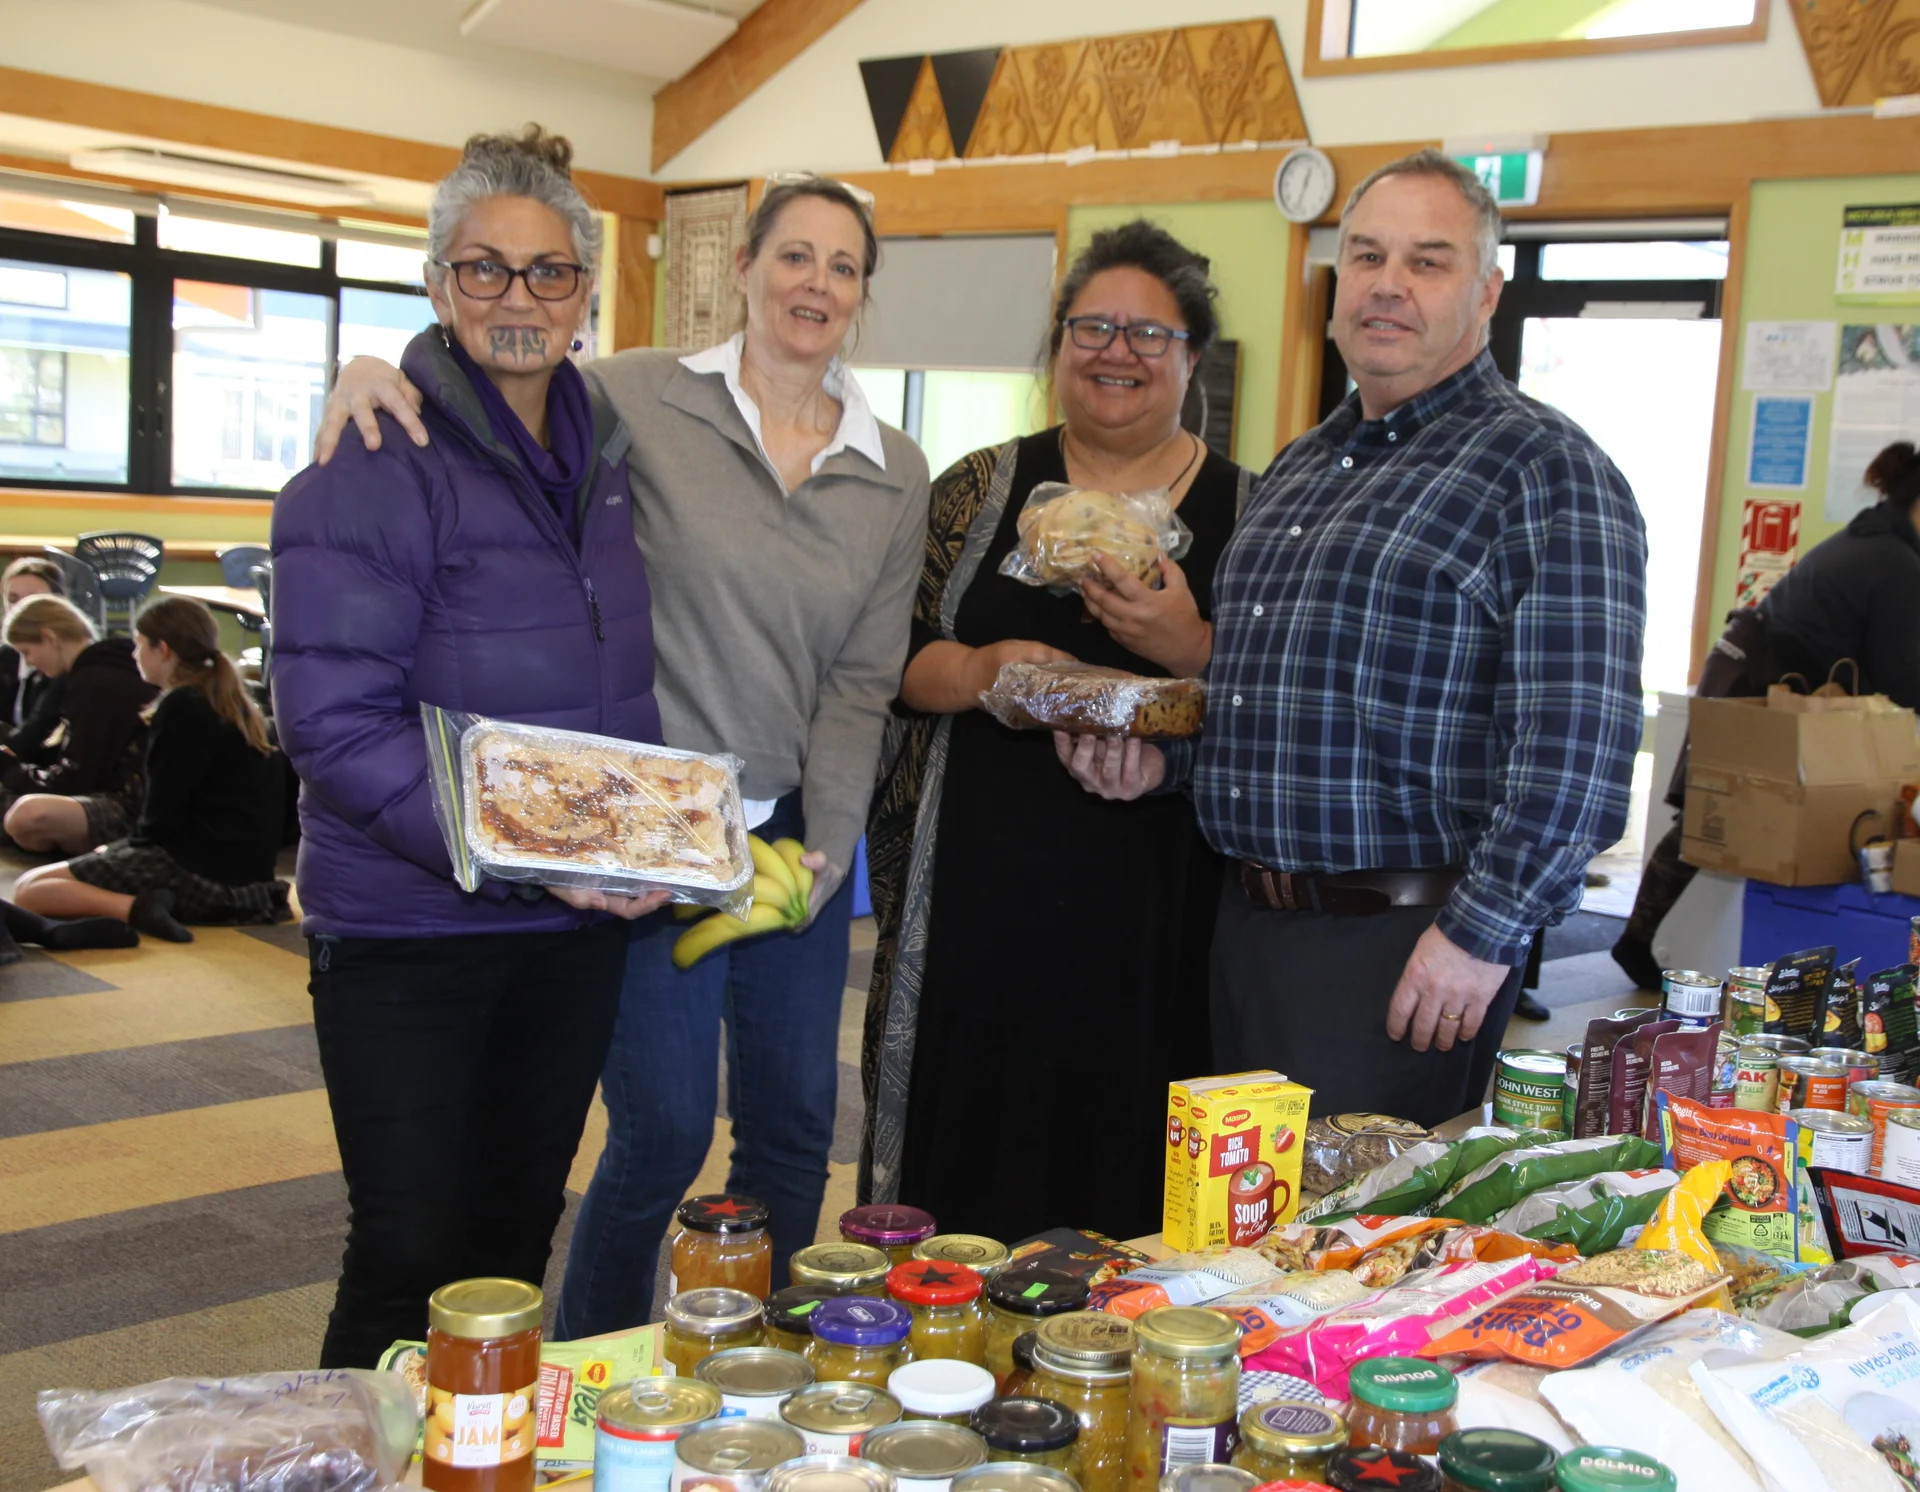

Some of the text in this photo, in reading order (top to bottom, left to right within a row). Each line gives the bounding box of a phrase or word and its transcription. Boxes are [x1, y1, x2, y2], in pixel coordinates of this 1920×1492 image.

[1737, 1070, 1768, 1083] AK
[1497, 1076, 1560, 1098] JOHN WEST
[1744, 1086, 1764, 1094] SALAD
[1512, 1100, 1534, 1112] STYLE
[1536, 1104, 1556, 1112] TUNA
[1225, 1112, 1248, 1124] Maggi
[1228, 1136, 1243, 1151] RICH
[1718, 1131, 1751, 1147] Original
[1220, 1148, 1249, 1167] TOMATO
[1235, 1198, 1268, 1224] SOUP
[1235, 1227, 1244, 1241] for
[1250, 1220, 1268, 1234] Cup
[1525, 1287, 1602, 1311] BROWN RIC
[1462, 1311, 1566, 1348] Ben's
[1848, 1341, 1920, 1378] LONG GRAIN
[1373, 1369, 1438, 1384] DOLMIO
[554, 1395, 566, 1414] PLANT
[456, 1425, 499, 1446] JAM
[550, 1414, 562, 1438] BASED
[1581, 1456, 1656, 1477] DOLMIO
